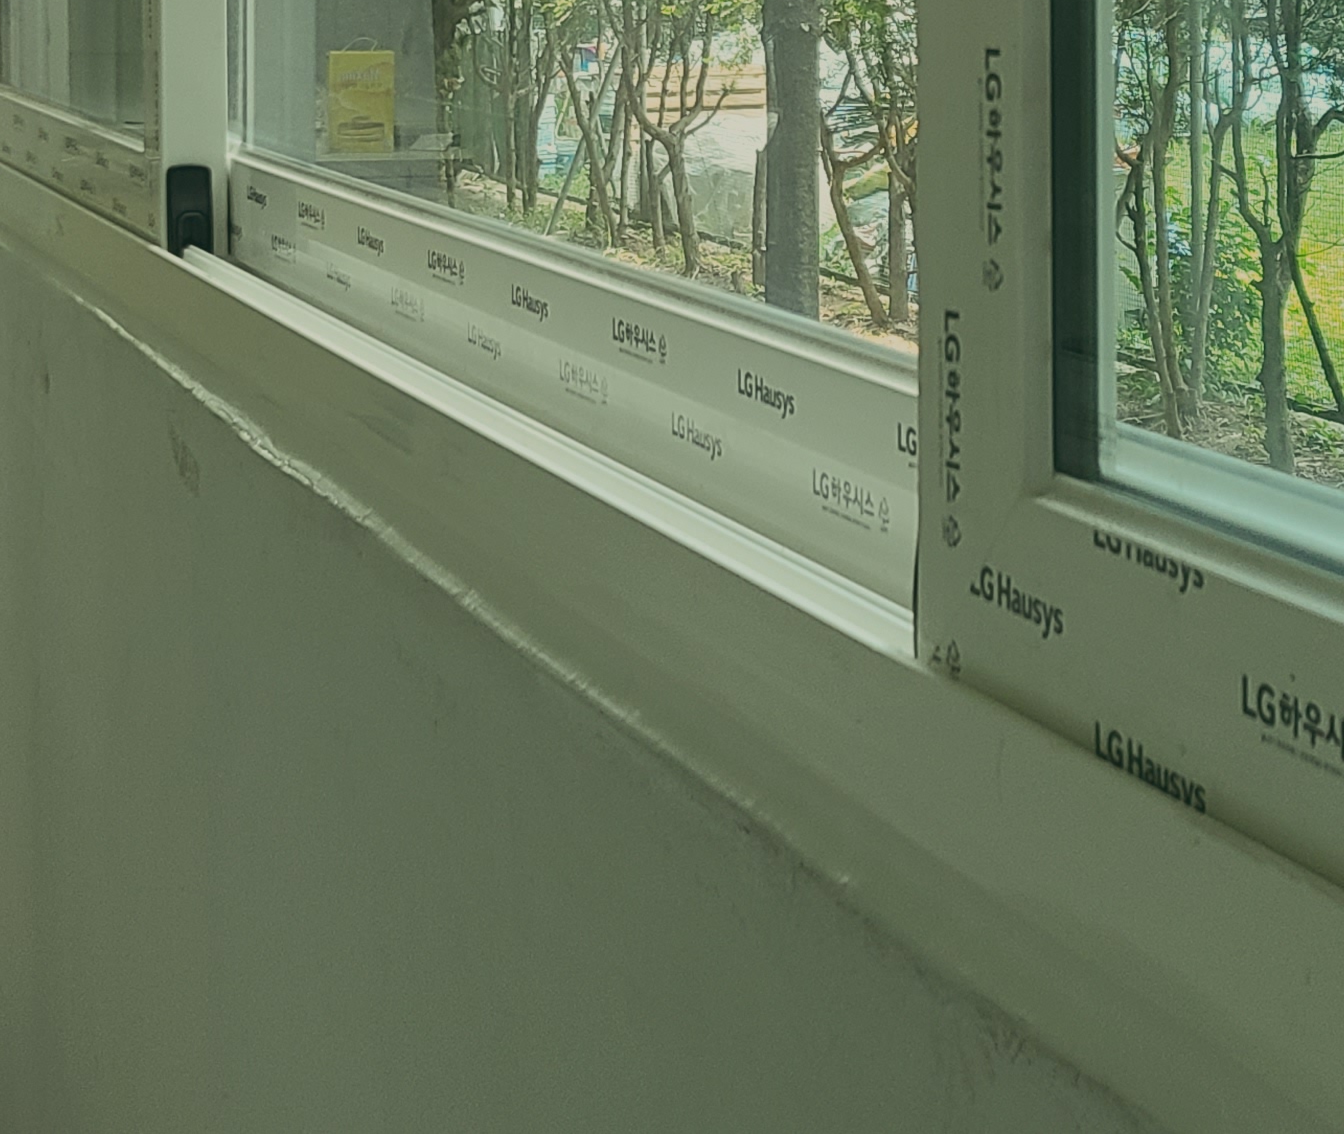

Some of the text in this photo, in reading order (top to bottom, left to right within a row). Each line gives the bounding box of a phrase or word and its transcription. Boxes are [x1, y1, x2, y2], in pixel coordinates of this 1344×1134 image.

[984, 47, 1003, 245] LG하우시스
[512, 284, 550, 322] LG Hausys
[612, 317, 657, 353] LG하우시스
[737, 368, 795, 419] LG Hausys
[943, 310, 961, 503] LG하우시스
[671, 412, 723, 460] LG Hausys
[897, 422, 917, 456] LG
[812, 468, 875, 517] LG하우시스
[997, 572, 1064, 640] Hausys
[1095, 719, 1125, 770] LG
